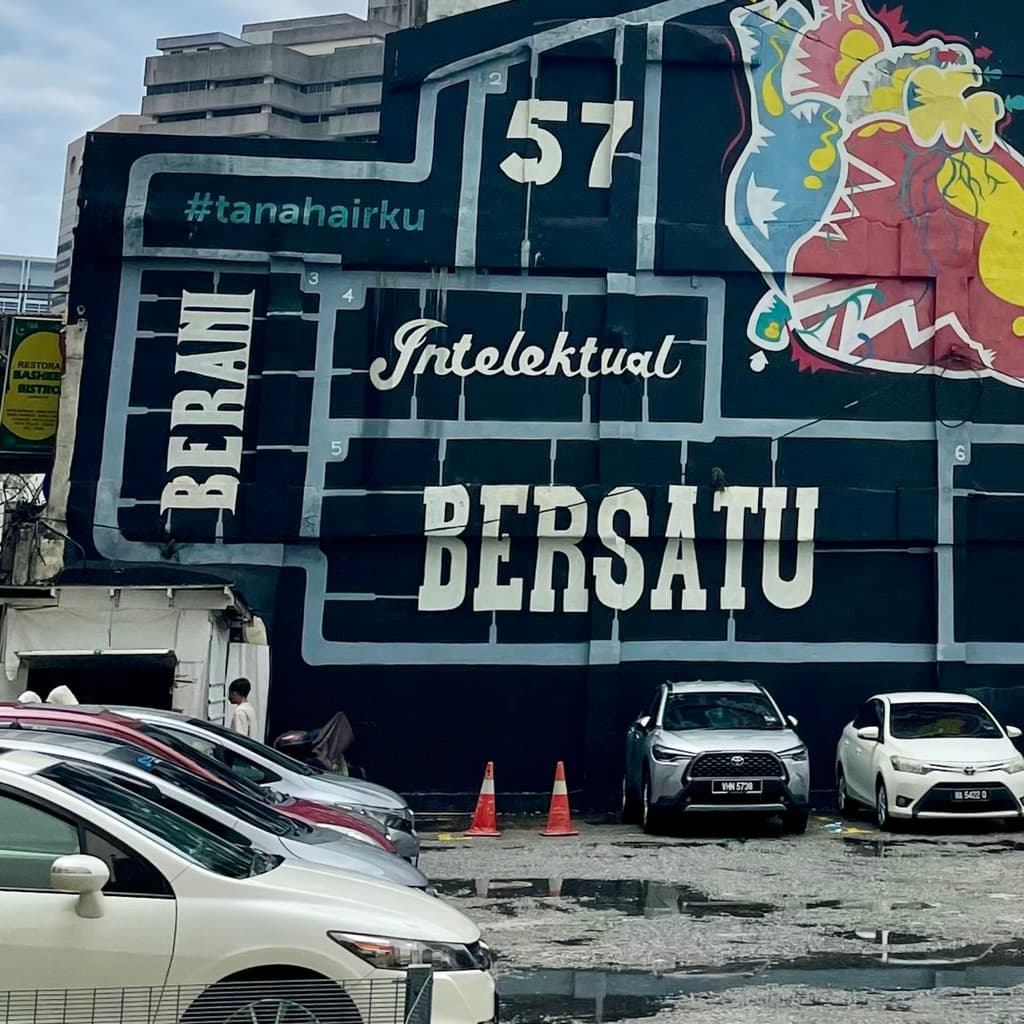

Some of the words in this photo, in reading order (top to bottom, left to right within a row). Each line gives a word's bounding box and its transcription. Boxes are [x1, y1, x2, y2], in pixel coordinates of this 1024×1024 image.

[488, 72, 502, 85] 2
[500, 98, 634, 188] 57
[184, 191, 426, 233] #tanahairku
[308, 272, 319, 285] 3
[342, 288, 355, 303] 4
[369, 318, 682, 391] Intelektual
[159, 288, 256, 516] BERANI
[331, 441, 342, 456] 5
[955, 445, 966, 461] 6
[417, 483, 820, 613] BERSATU
